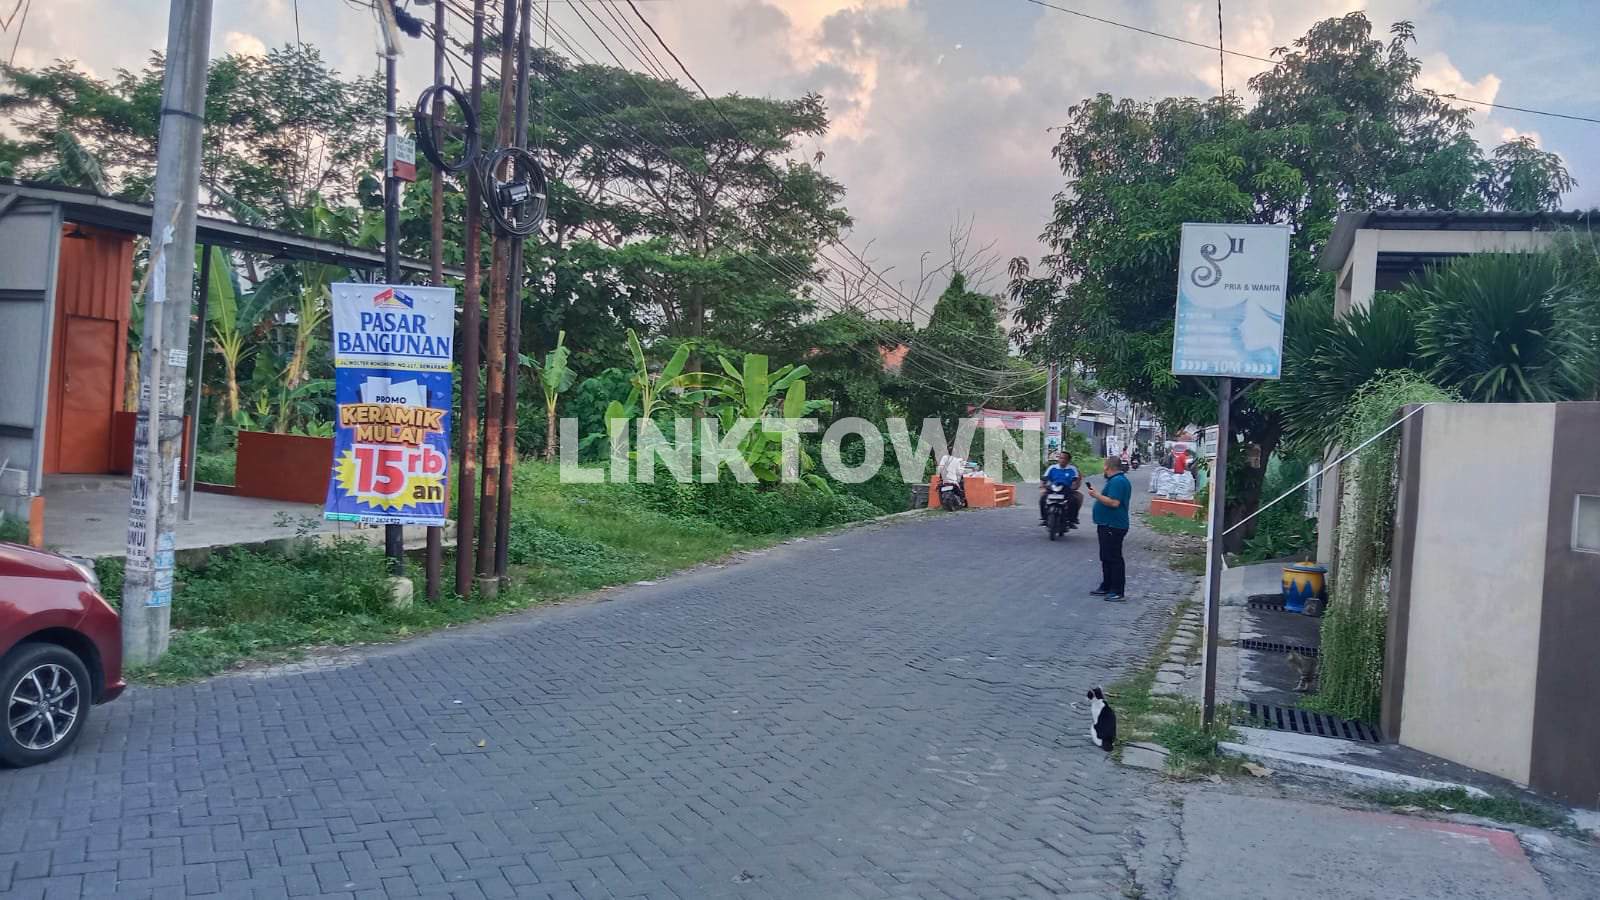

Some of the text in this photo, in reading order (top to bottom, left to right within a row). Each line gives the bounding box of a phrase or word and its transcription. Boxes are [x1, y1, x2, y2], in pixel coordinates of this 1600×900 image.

[1224, 283, 1242, 291] PRIA
[1251, 284, 1281, 292] WANITA
[360, 312, 427, 334] PASAR
[338, 332, 450, 356] BANGUNAN
[375, 395, 407, 404] PROMO
[341, 406, 442, 430] KERAMIK
[356, 425, 424, 446] MULAI
[413, 484, 441, 500] an
